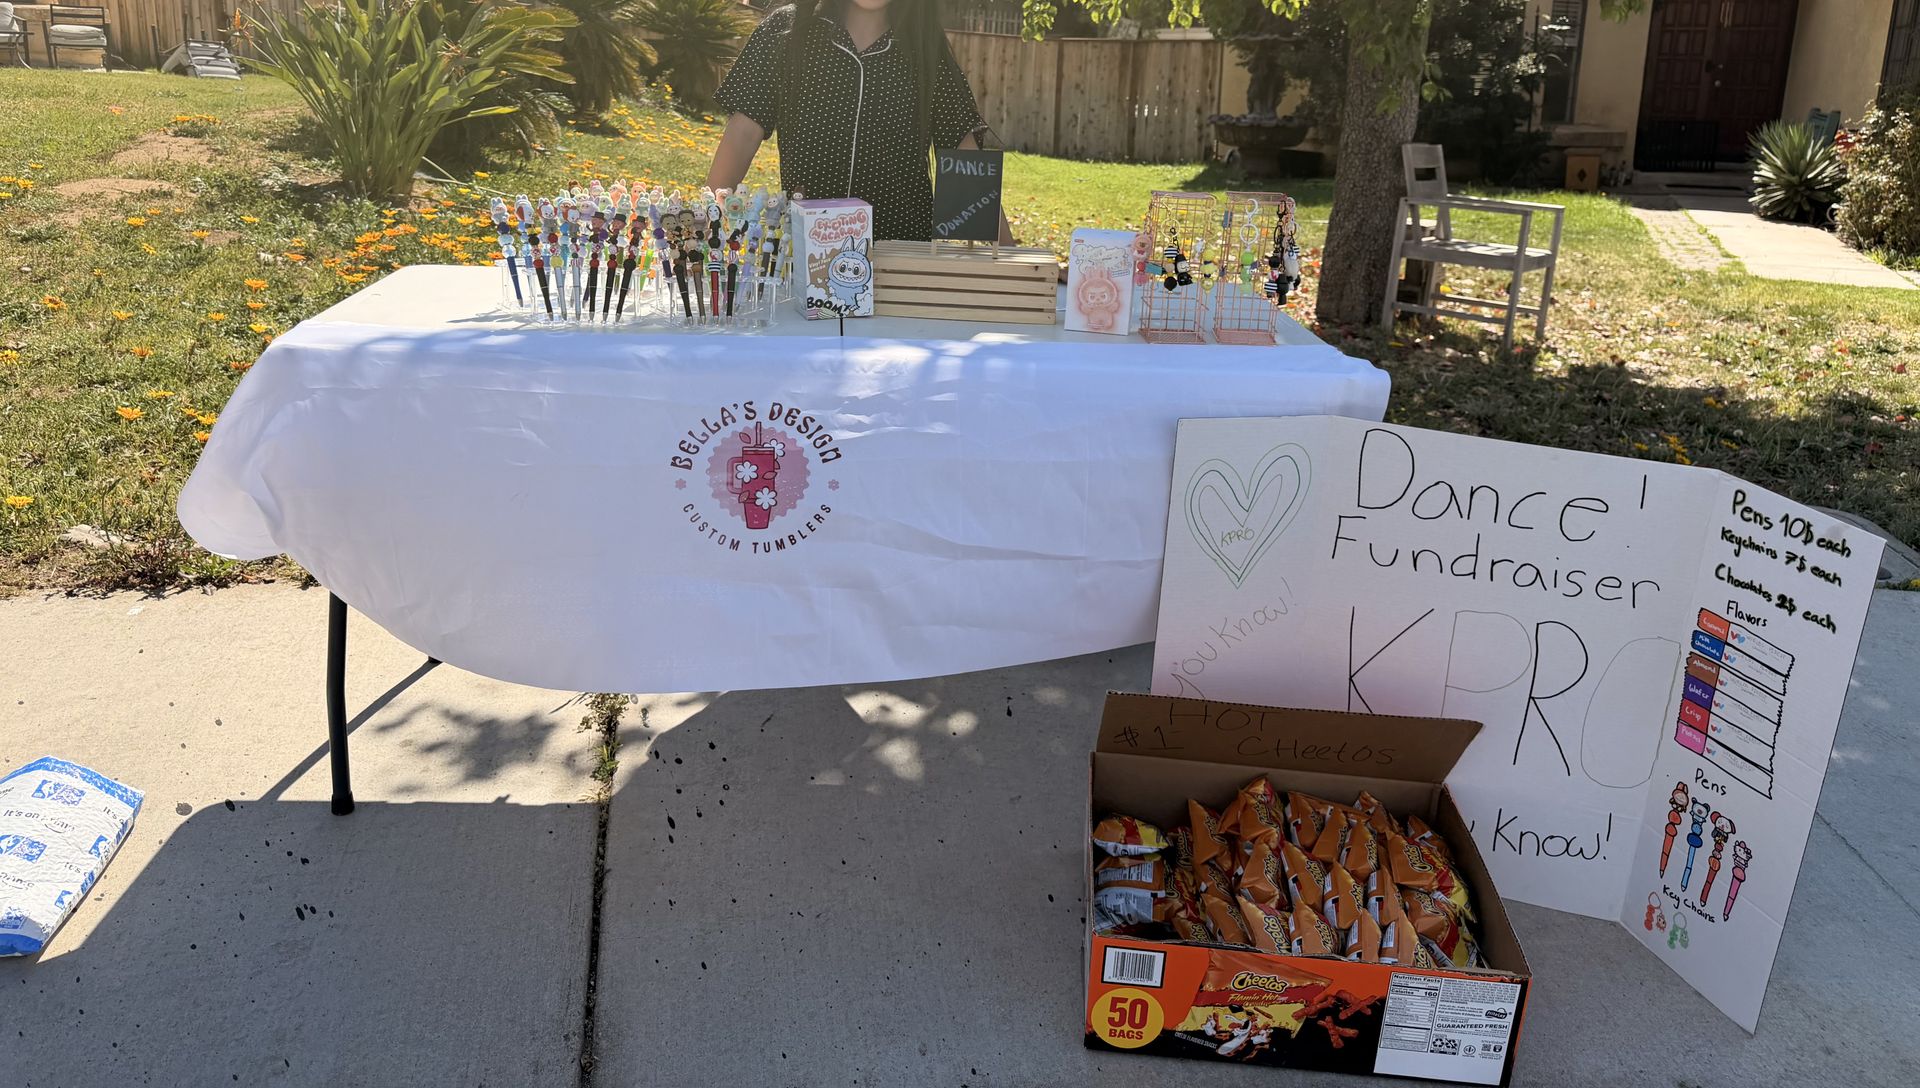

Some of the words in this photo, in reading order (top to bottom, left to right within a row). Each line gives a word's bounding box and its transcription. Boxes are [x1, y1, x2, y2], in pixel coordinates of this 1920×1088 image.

[940, 156, 997, 177] DANCE
[936, 189, 998, 237] DONATION
[670, 400, 757, 471] BELLA'S
[682, 503, 741, 552] CUSTOM
[752, 503, 832, 554] TUMBLERS
[1731, 488, 1774, 531] Pens
[1816, 536, 1852, 559] each
[1331, 513, 1661, 609] Fundraiser
[1720, 525, 1778, 558] Keychains
[1810, 565, 1843, 588] each
[1714, 562, 1773, 603] Chocolates
[1802, 609, 1837, 634] each
[1726, 599, 1768, 628] Flavors
[1688, 683, 1710, 700] Wafer
[1168, 701, 1282, 733] HOT
[1694, 767, 1727, 797] Pens
[3, 808, 24, 818] It's
[1493, 807, 1613, 861] Know!
[1662, 884, 1681, 910] Key
[1232, 971, 1289, 994] Cheetos
[1393, 974, 1422, 982] Nutrition
[1107, 996, 1149, 1030] 50
[1436, 1022, 1484, 1030] GUARANTEED
[1484, 1023, 1508, 1031] FRESH
[1108, 1028, 1144, 1041] BAGS
